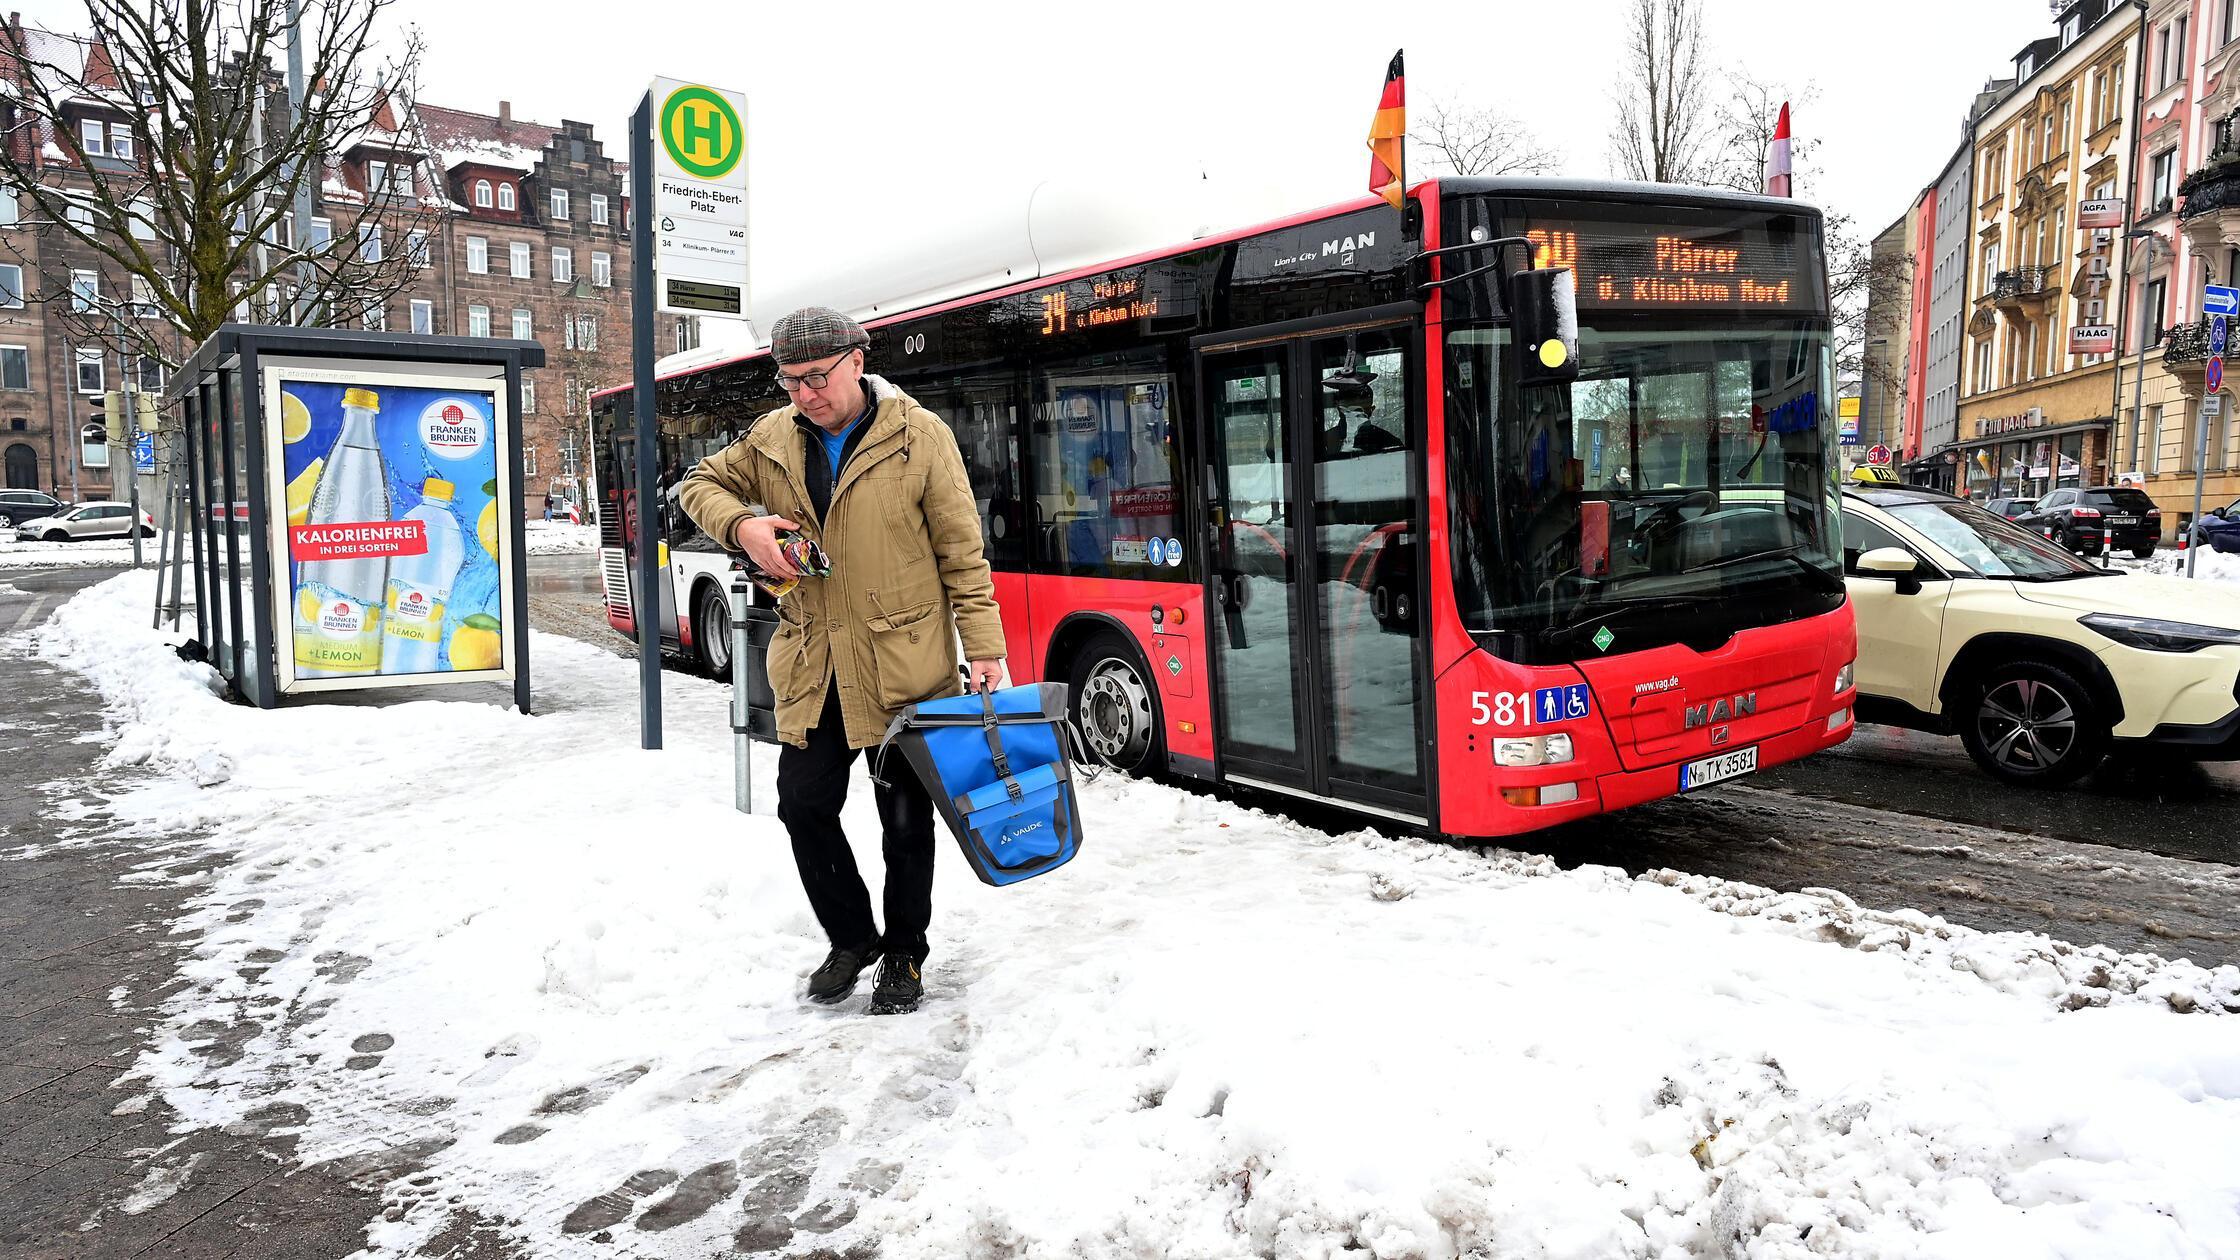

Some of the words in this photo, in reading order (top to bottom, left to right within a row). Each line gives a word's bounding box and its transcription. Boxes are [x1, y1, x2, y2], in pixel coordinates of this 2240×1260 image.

[683, 106, 721, 159] H
[662, 183, 742, 204] Friedrich-Ebert-
[690, 200, 716, 213] Platz
[2082, 204, 2106, 212] AGFA
[729, 230, 744, 238] VAG
[1274, 256, 1297, 267] Lion's
[1299, 252, 1317, 261] City
[1322, 231, 1375, 257] MAN
[1656, 237, 1738, 272] Plärrer
[672, 282, 679, 290] 34
[1632, 277, 1729, 301] Klinikum
[1739, 279, 1788, 303] Nord
[672, 296, 679, 304] 34
[1042, 291, 1067, 335] 34
[1094, 279, 1136, 300] Plärrer
[1089, 307, 1128, 326] Klinikum
[1130, 297, 1158, 318] Nord
[2077, 329, 2108, 338] HAAG
[430, 425, 476, 434] FRANKEN
[1986, 419, 2002, 434] OTO
[2004, 414, 2026, 432] HAAG
[430, 434, 476, 442] BRUNNEN
[1840, 436, 1846, 444] P
[296, 526, 418, 544] KALORIENFREI
[335, 545, 356, 554] DREI
[359, 544, 399, 552] SORTEN
[1168, 550, 1180, 559] free
[1598, 634, 1610, 643] CNG
[1635, 676, 1679, 693] www.vag.de
[1472, 691, 1531, 726] 581
[1685, 692, 1756, 728] MAN
[1688, 764, 1698, 786] N
[1706, 760, 1722, 780] TX
[1724, 750, 1754, 775] 3581
[1013, 821, 1043, 837] VAUDE
